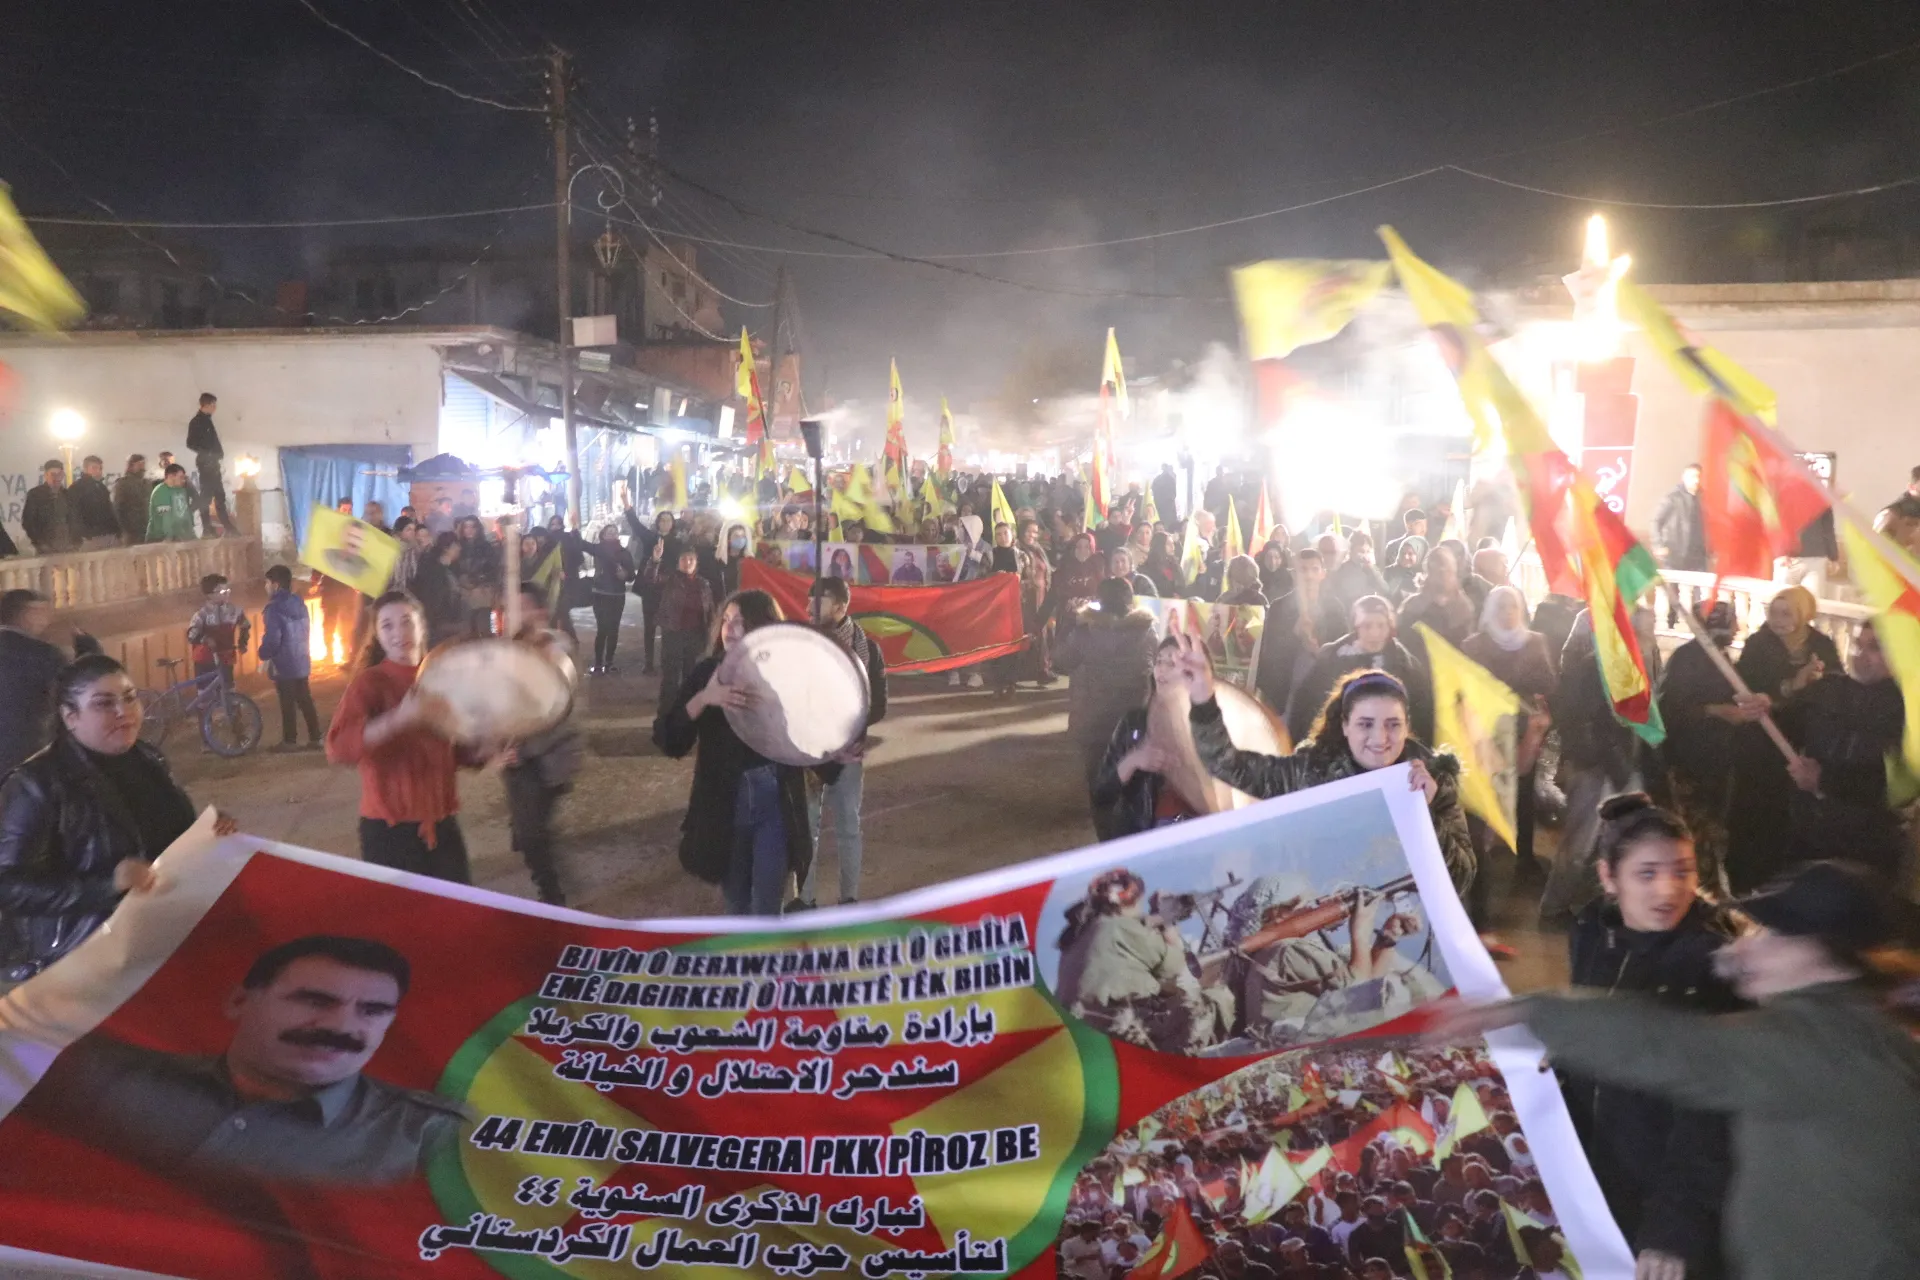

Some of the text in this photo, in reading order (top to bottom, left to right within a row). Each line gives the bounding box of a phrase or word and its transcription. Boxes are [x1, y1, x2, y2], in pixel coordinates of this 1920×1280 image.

[559, 945, 595, 968] BI
[597, 948, 647, 974] VÎN
[671, 944, 852, 978] BERXWEDANA
[857, 937, 901, 970] GEL
[933, 913, 1028, 961] GERÎLA
[541, 974, 603, 1003] EMÊ
[602, 980, 753, 1011] DAGIRKERÎ
[780, 973, 892, 1009] ÎXANETÊ
[901, 968, 950, 1001] TÊK
[953, 951, 1034, 994] BIBÎN
[527, 1002, 996, 1054] بإرادة مقاومة الشعوب والكريلا
[554, 1050, 958, 1099] سندحر الاحتلال و الخيانة
[470, 1114, 1039, 1175] 44 EMÎN SALVEGERA PKK PÎROZ BE
[515, 1175, 923, 1235] نبارك لذكرى السنوية ٤٤
[419, 1212, 1007, 1278] لتأسيس حزب العمال الكردستاني
